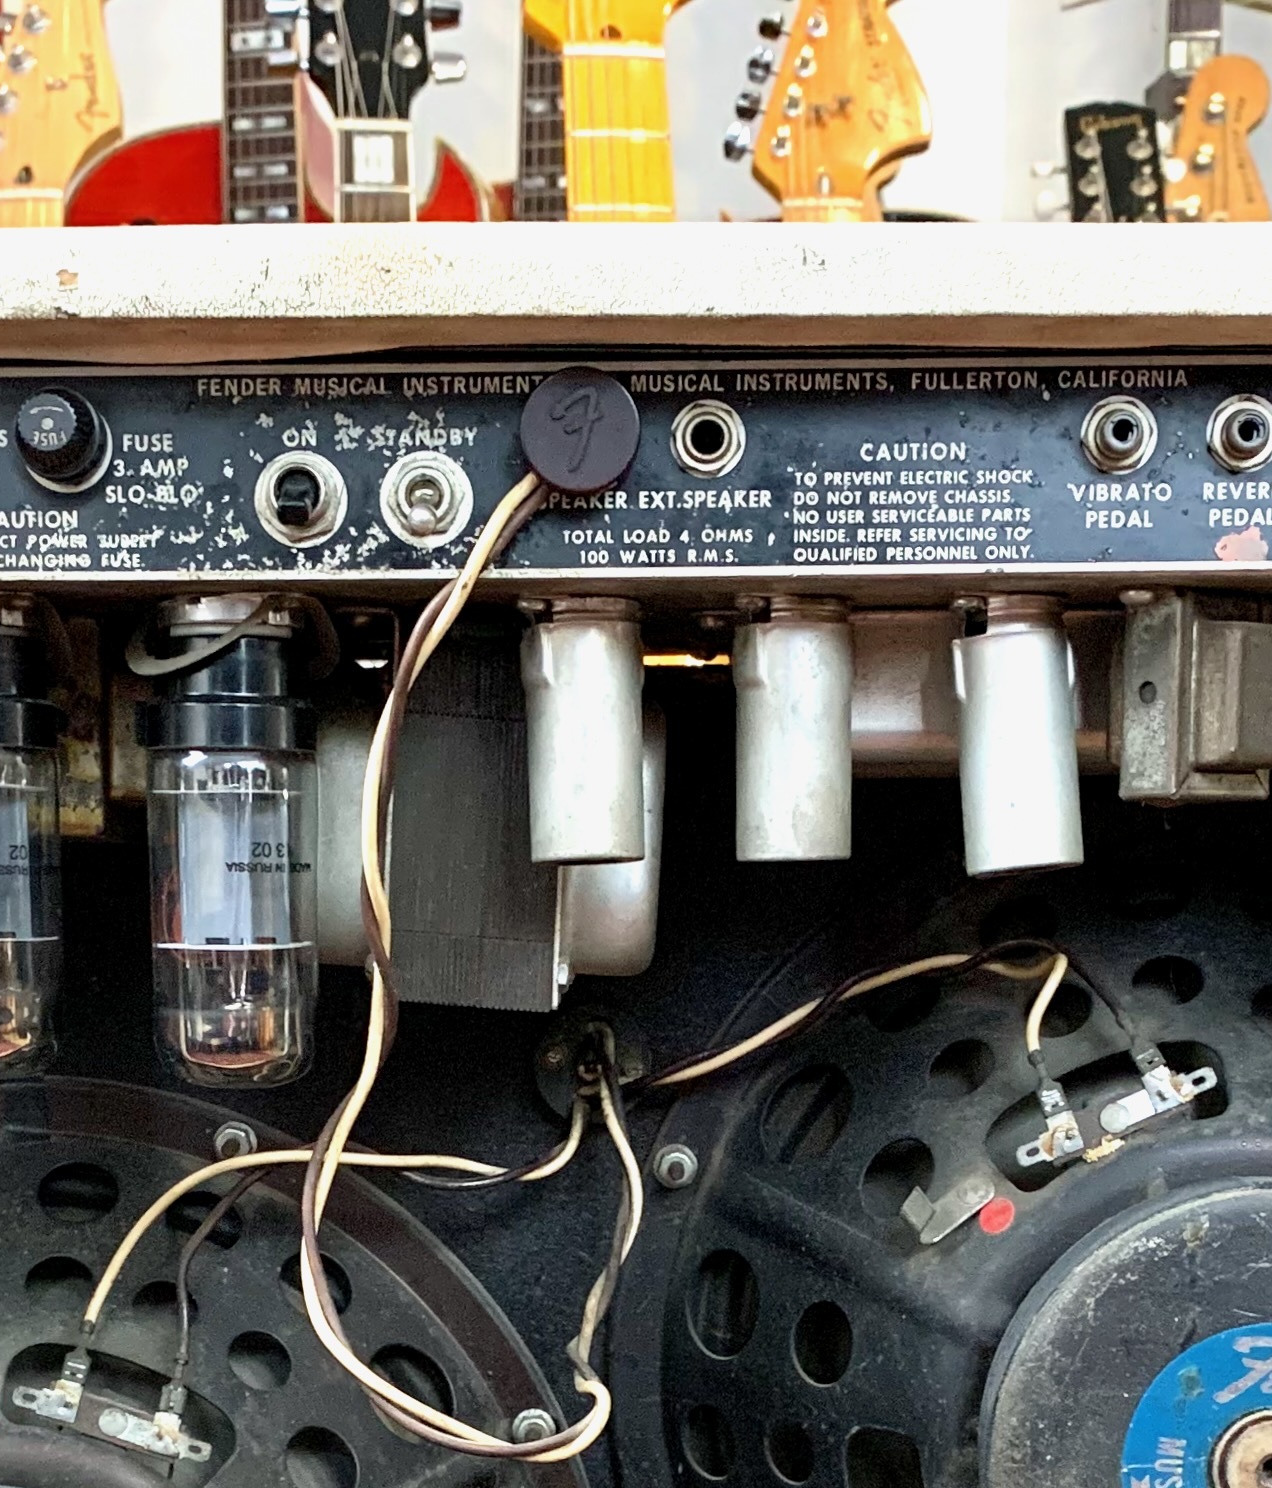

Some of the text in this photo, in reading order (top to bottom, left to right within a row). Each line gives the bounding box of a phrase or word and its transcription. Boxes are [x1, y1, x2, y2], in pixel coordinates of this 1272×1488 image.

[197, 378, 281, 397] FENDER
[294, 377, 389, 397] MUSICAL
[631, 373, 725, 393] MUSICAL
[736, 372, 894, 393] INSTRUMENTS,
[911, 370, 1047, 391] FULLERTON,
[1058, 369, 1189, 389] CALIFORNIA
[122, 433, 174, 453] FUSE
[281, 427, 318, 448] ON
[375, 424, 478, 449] STANDBY
[859, 442, 968, 462] CAUTION
[140, 457, 189, 478] AMP
[794, 468, 1033, 486] TO PREVENT ELECTRIC SHOCK
[793, 491, 819, 506] DO
[827, 490, 863, 505] NOT
[869, 490, 938, 505] REMOVE
[1068, 482, 1173, 502] VIBRATO
[793, 507, 1031, 524] NO USER SERVICEABLE PARTS
[1085, 509, 1154, 529] PEDAL
[26, 534, 89, 552] POWER
[562, 529, 614, 545] TOTAL
[623, 528, 671, 544] LOAD
[700, 528, 754, 543] OHMS
[793, 526, 1030, 544] INSIDE. REFER SERVICING TO
[580, 549, 739, 565] 100 WATTS R.M.S.
[793, 544, 1035, 563] QUALIFIED PERSONNEL ONLY.
[224, 861, 273, 874] RUSSIA
